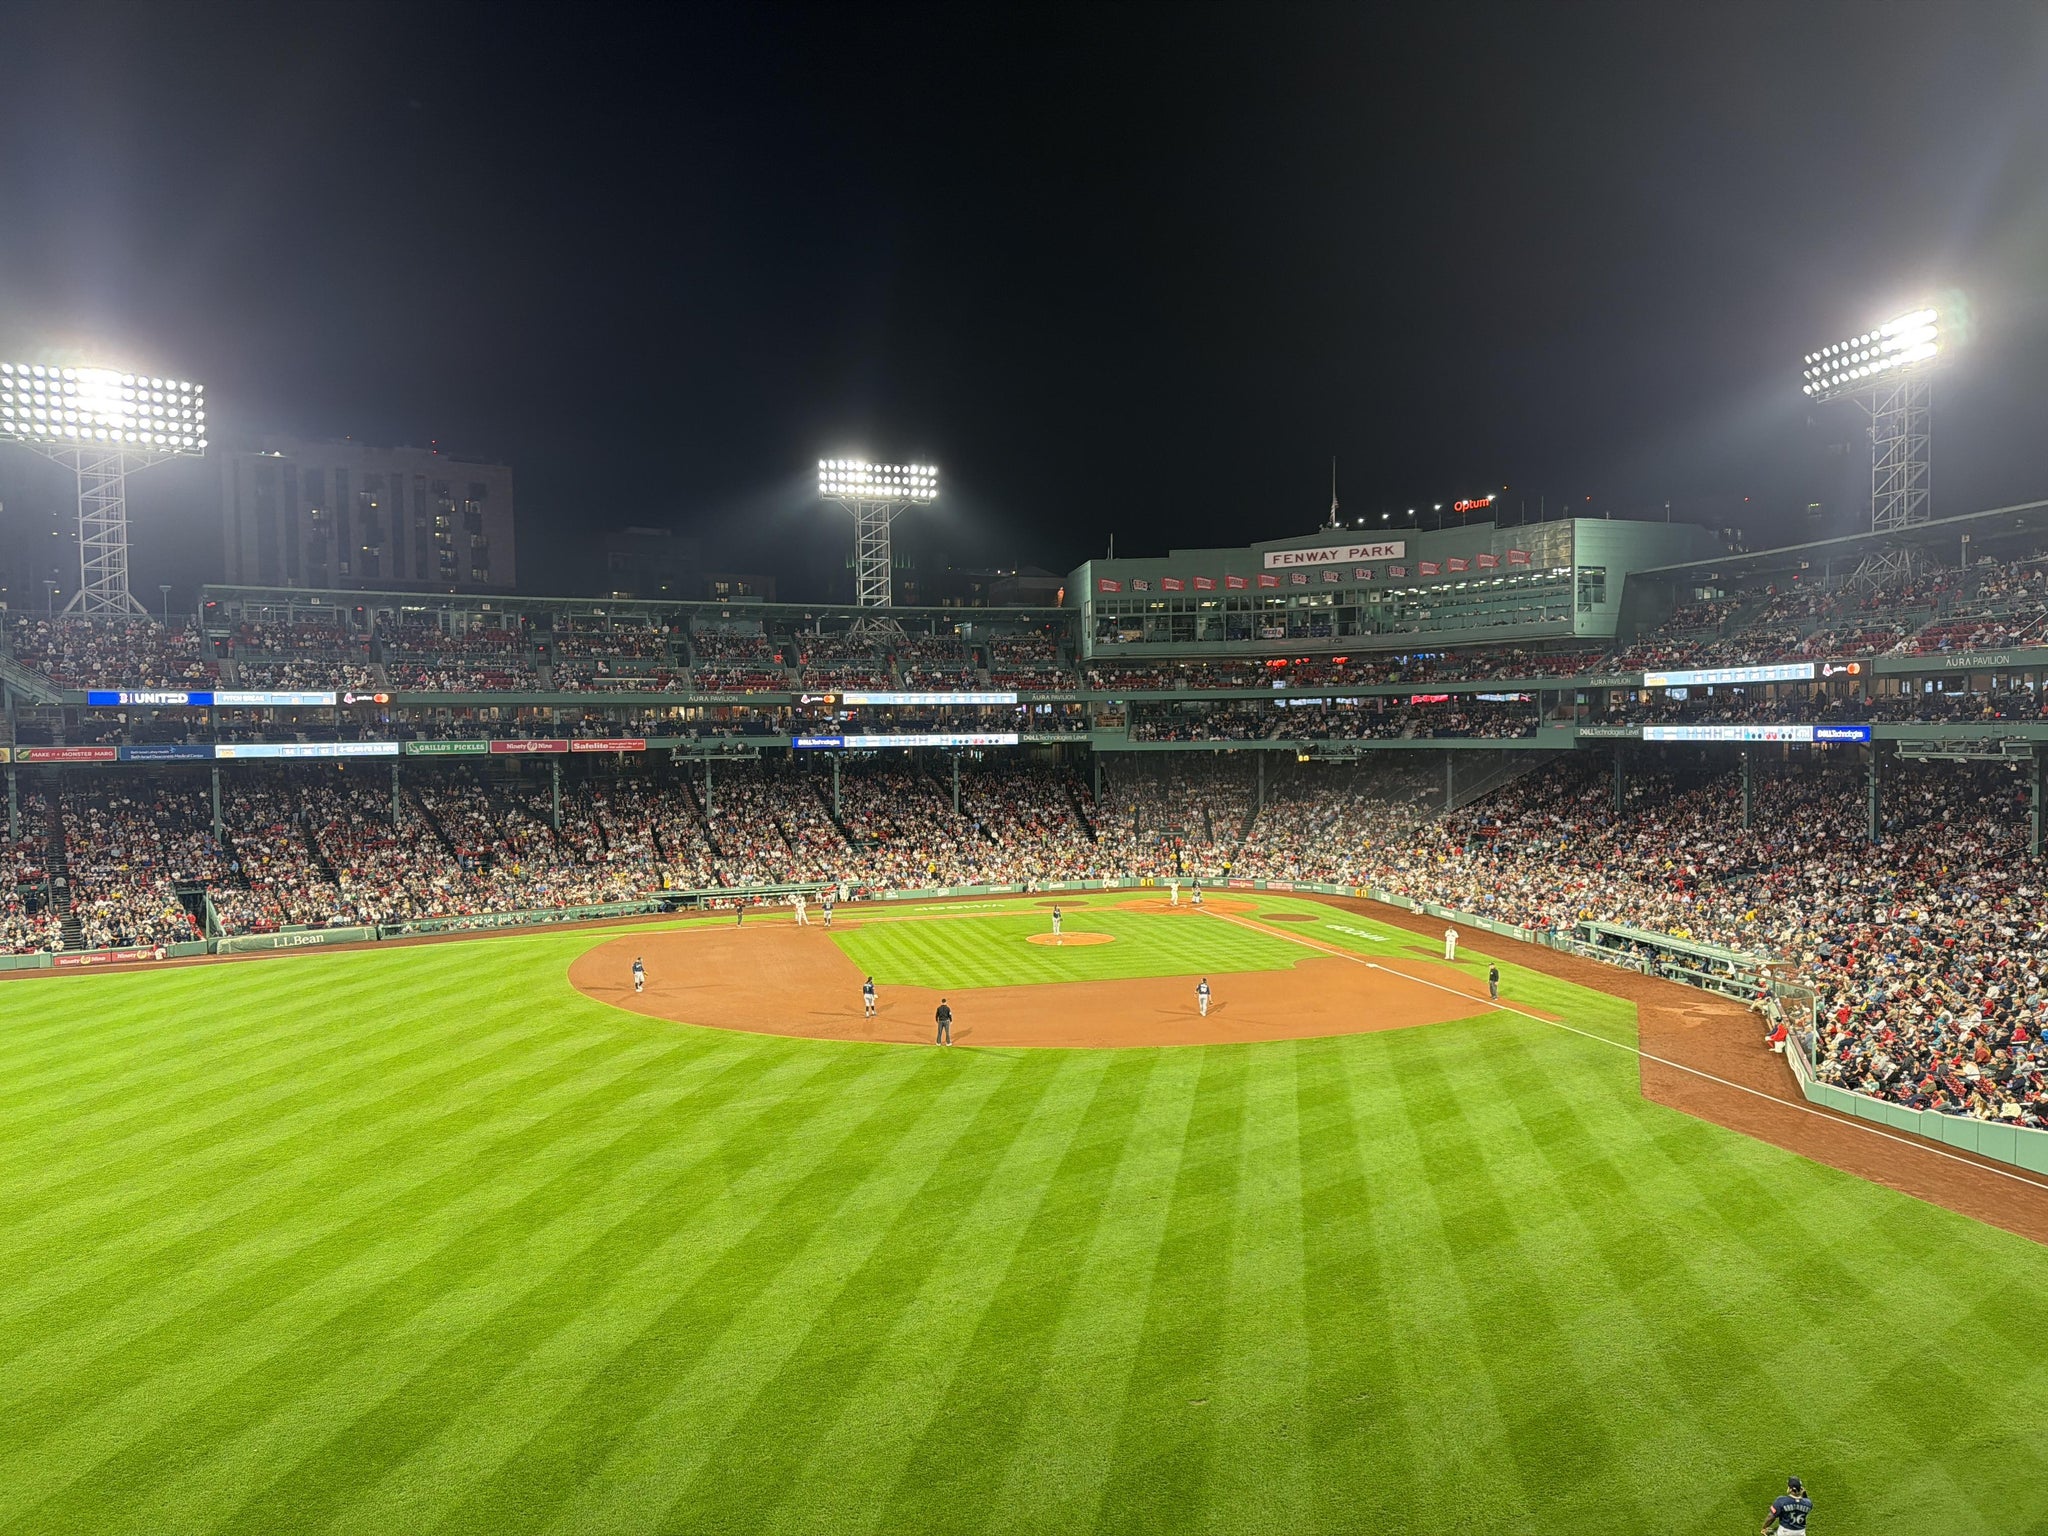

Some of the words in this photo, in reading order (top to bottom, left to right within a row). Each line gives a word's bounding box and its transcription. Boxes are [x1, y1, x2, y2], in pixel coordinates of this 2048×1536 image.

[1454, 498, 1490, 513] Optum
[1272, 549, 1339, 565] FENWAY
[1349, 544, 1395, 559] PARK
[1972, 655, 2010, 666] PAVILION
[134, 693, 189, 704] UNITED
[573, 742, 609, 750] Safelite
[273, 934, 324, 948] L.L.Bean
[1790, 1512, 1805, 1525] 56
